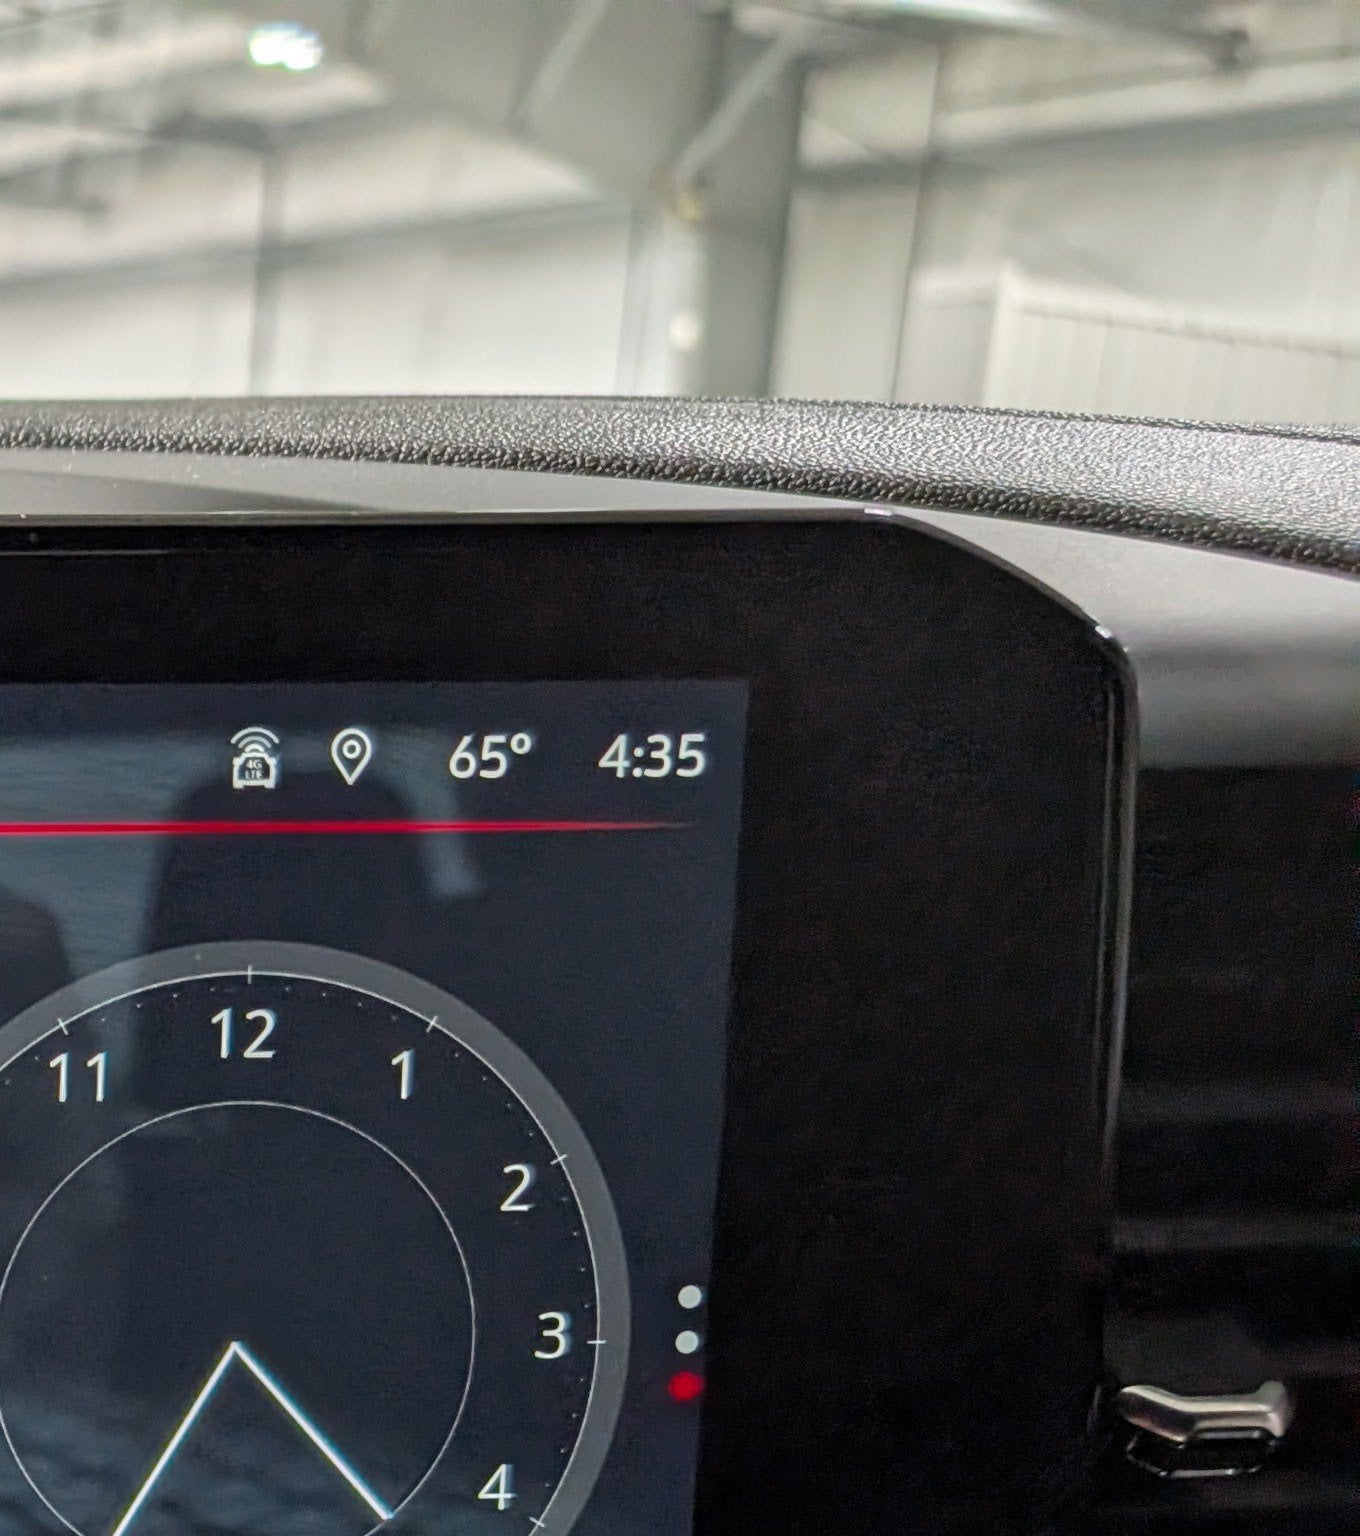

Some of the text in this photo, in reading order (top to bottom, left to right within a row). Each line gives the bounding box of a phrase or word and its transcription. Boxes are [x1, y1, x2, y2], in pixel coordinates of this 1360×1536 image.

[449, 732, 532, 779] 65°
[598, 733, 706, 778] 4:35
[211, 1007, 276, 1059] 12
[49, 1052, 107, 1103] 11
[391, 1050, 413, 1100] 1
[500, 1163, 532, 1212] 2
[534, 1311, 570, 1359] 3
[477, 1463, 516, 1511] 4
